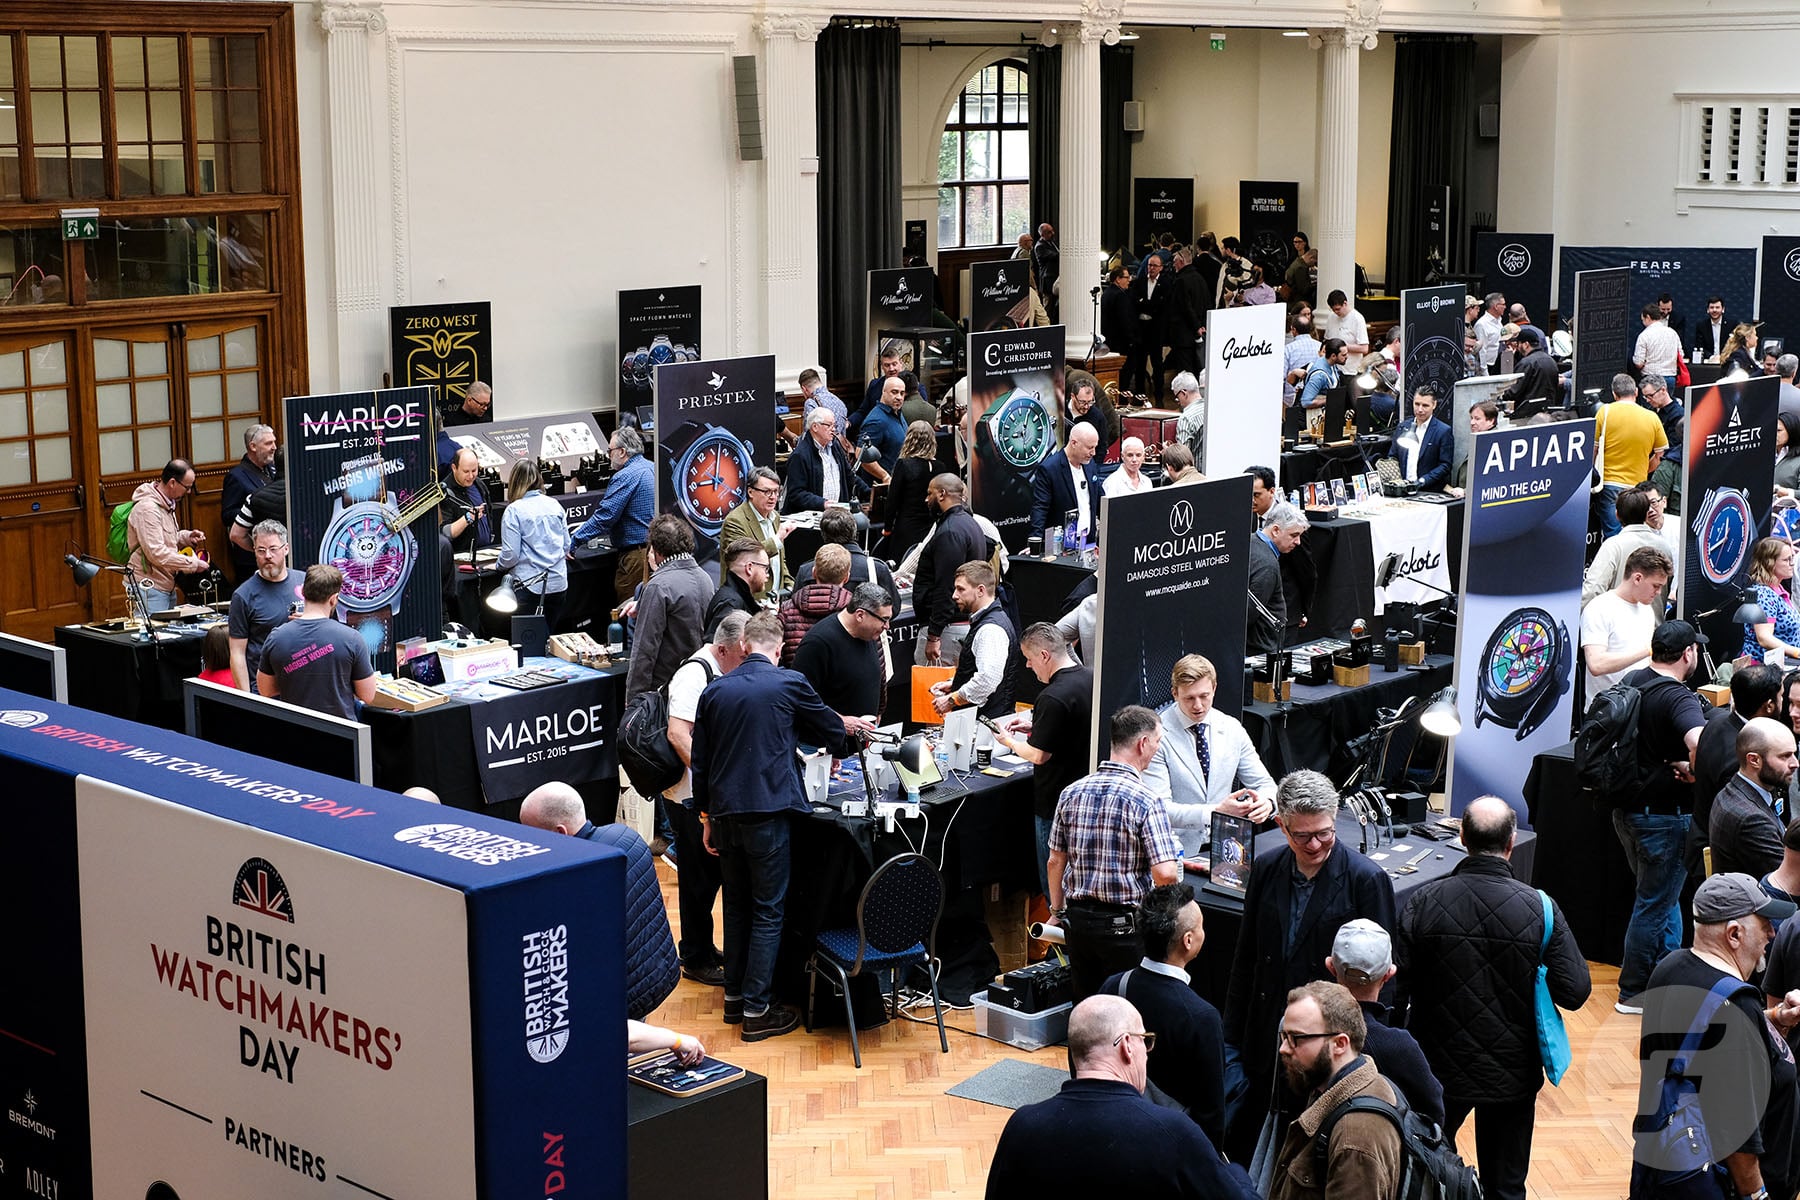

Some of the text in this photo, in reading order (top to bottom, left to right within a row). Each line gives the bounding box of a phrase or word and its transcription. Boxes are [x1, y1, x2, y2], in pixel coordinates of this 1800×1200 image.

[1630, 260, 1681, 270] FEARS
[406, 314, 478, 330] ZERO WEST
[1004, 342, 1036, 351] EDWARD
[1004, 351, 1052, 363] CHRISTOPHER
[1222, 335, 1272, 369] Geckota
[678, 390, 756, 410] PRESTEX
[303, 403, 420, 437] MARLOE
[342, 438, 362, 449] EST.
[1482, 430, 1586, 475] APIAR
[1706, 442, 1760, 457] WATCH COMPANY
[323, 458, 405, 495] HAGGIS WORKS
[341, 453, 372, 471] PROPERTY
[1481, 479, 1552, 501] MIND THE GAP
[1134, 530, 1226, 564] MCQUAIDE
[1127, 554, 1230, 582] DAMASCUS STEEL WATCHES
[1145, 577, 1210, 597] www.mcquaide.co.uk
[284, 643, 335, 674] HAGGIS WORKS
[486, 704, 602, 754] MARLOE
[527, 746, 567, 763] EST. 2015
[30, 724, 377, 820] BRITISH WATCHMAKERS' DAY
[406, 837, 500, 866] MAKERS
[449, 827, 551, 857] BRITISH
[206, 915, 326, 995] BRITISH
[523, 931, 544, 1037] BRITISH
[541, 930, 552, 1031] WATCH & CLOCK
[548, 924, 569, 1030] MAKERS
[150, 943, 401, 1071] WATCHMAKERS'
[240, 1025, 300, 1084] DAY
[8, 1109, 56, 1140] BREMONT
[225, 1116, 326, 1182] PARTNERS
[543, 1132, 566, 1196] DAY
[26, 1167, 58, 1200] ADLEY
